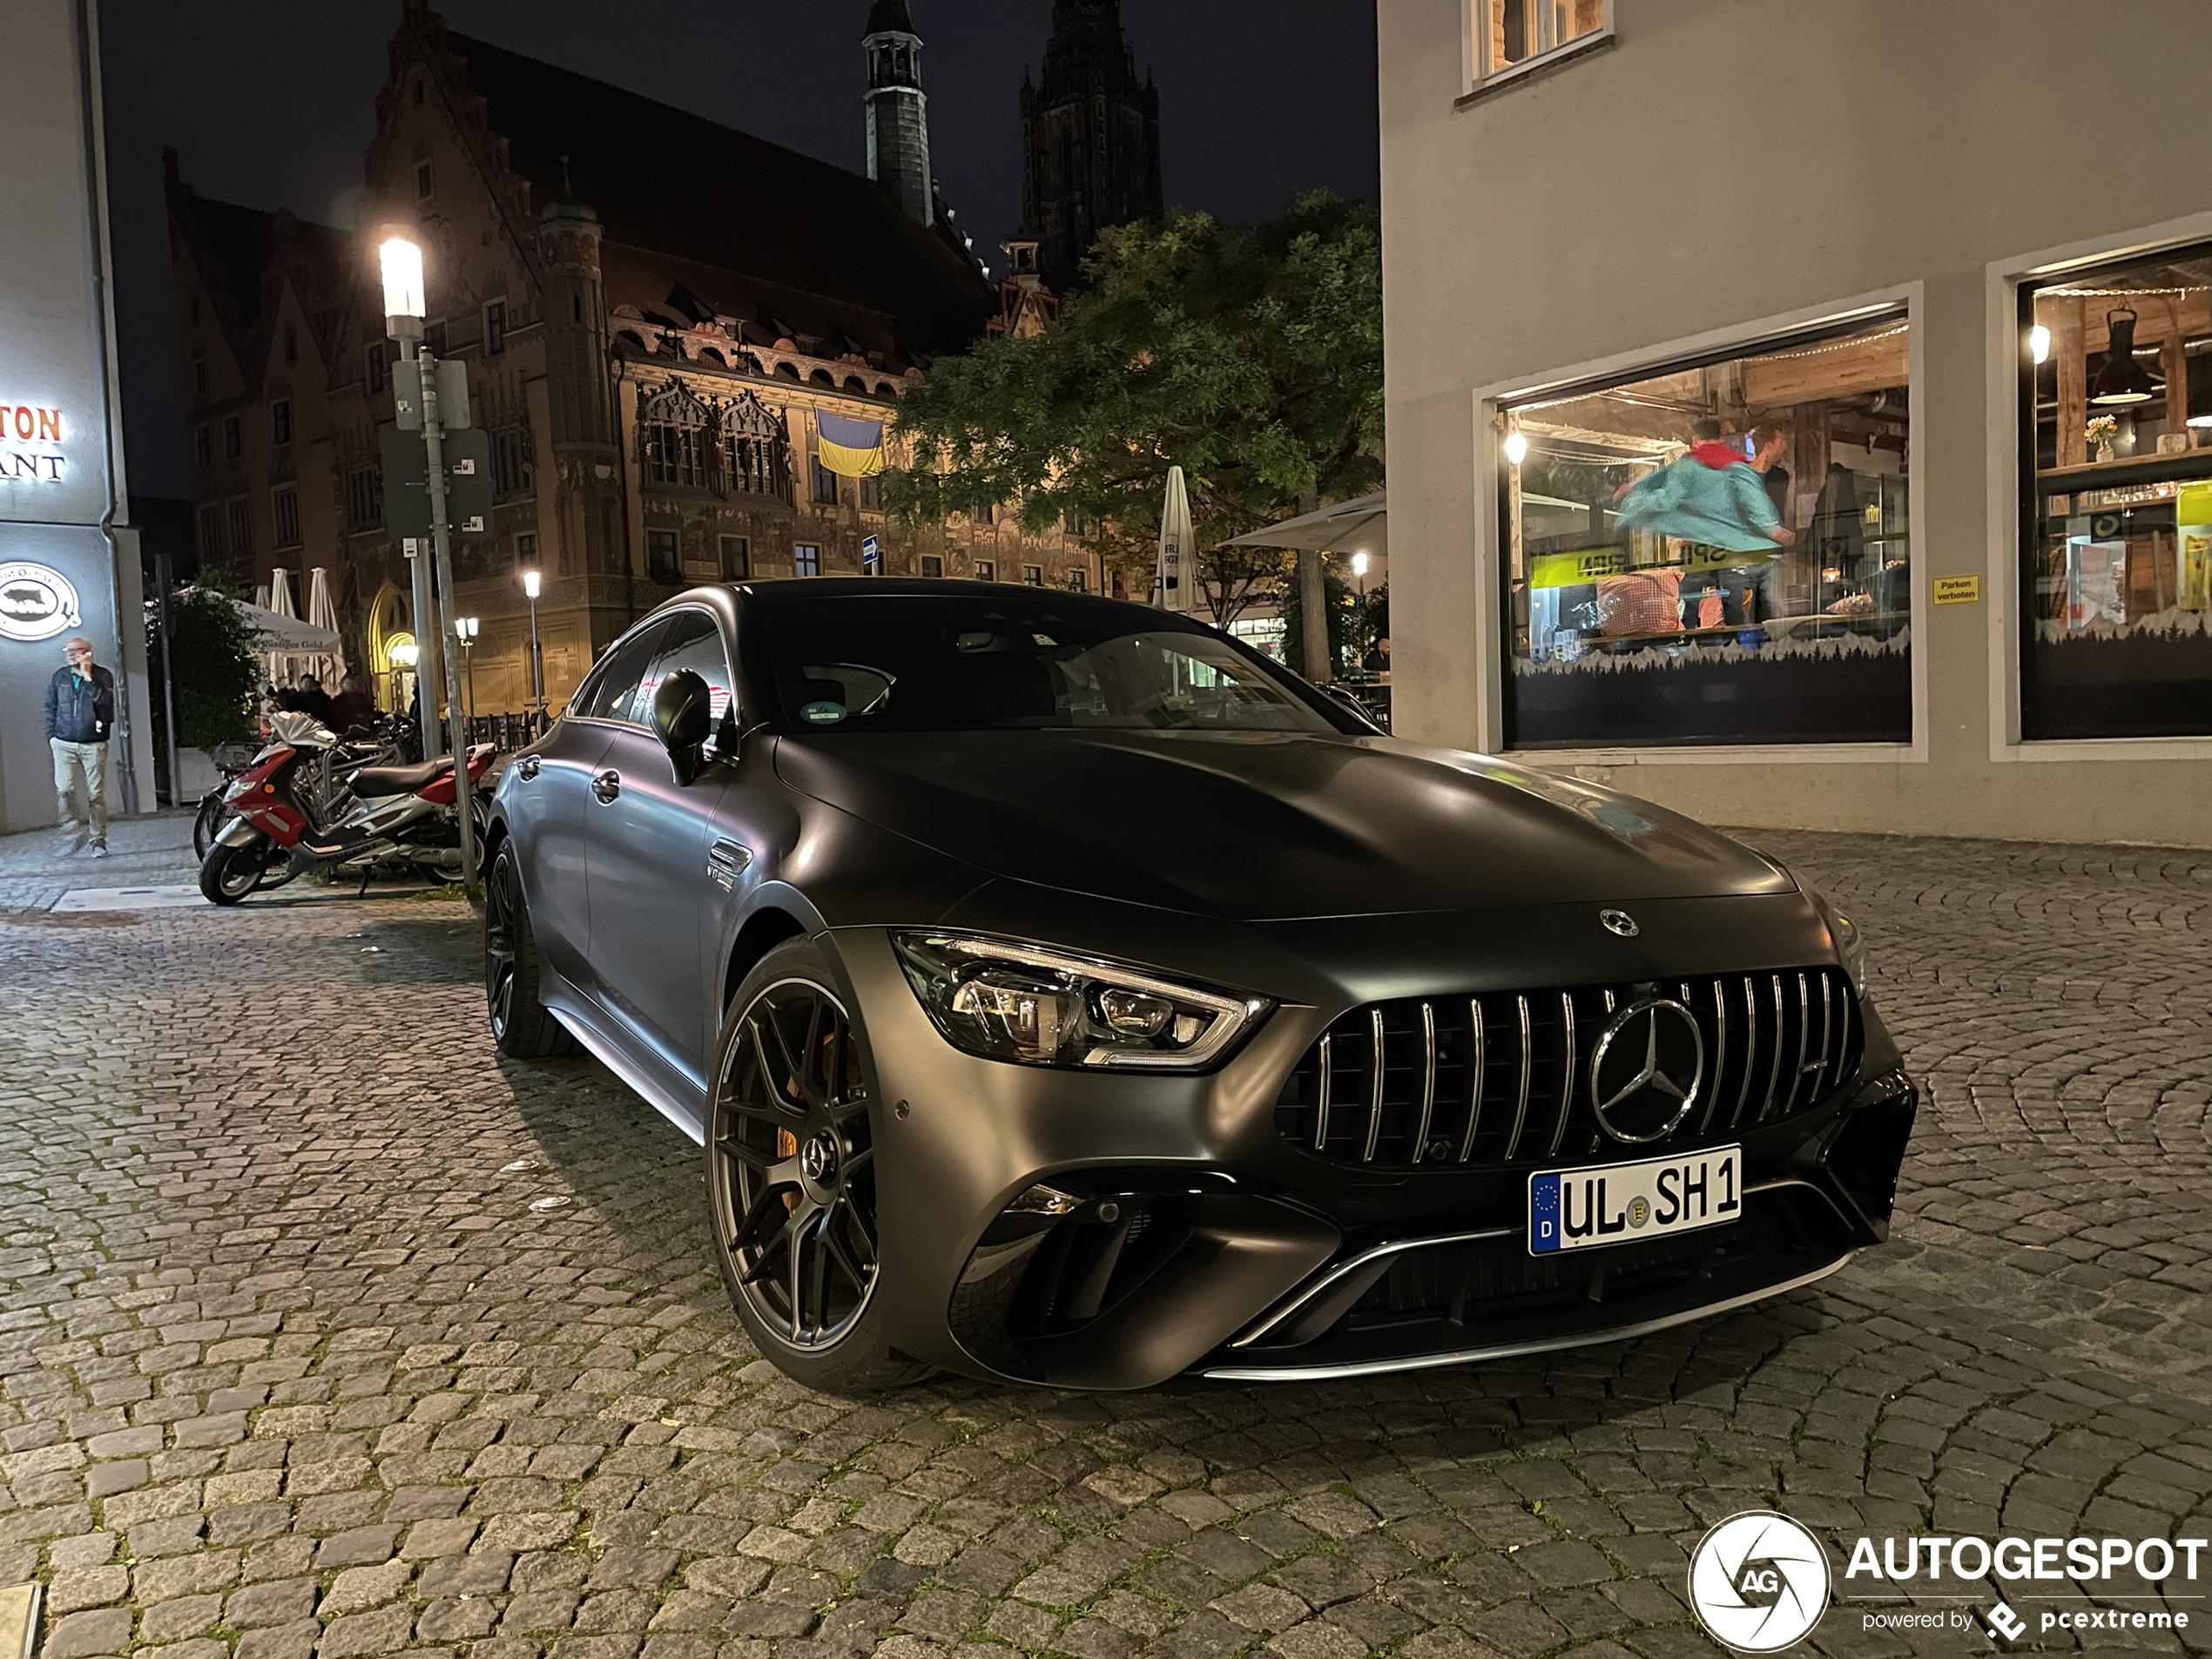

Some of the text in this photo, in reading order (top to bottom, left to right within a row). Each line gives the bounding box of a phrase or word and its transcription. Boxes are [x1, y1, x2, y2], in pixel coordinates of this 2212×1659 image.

[1941, 581, 1971, 590] Parken
[1938, 591, 1975, 600] verboten
[301, 640, 323, 649] Gold
[1563, 1157, 1738, 1238] UL SH 1
[1541, 1220, 1552, 1238] D
